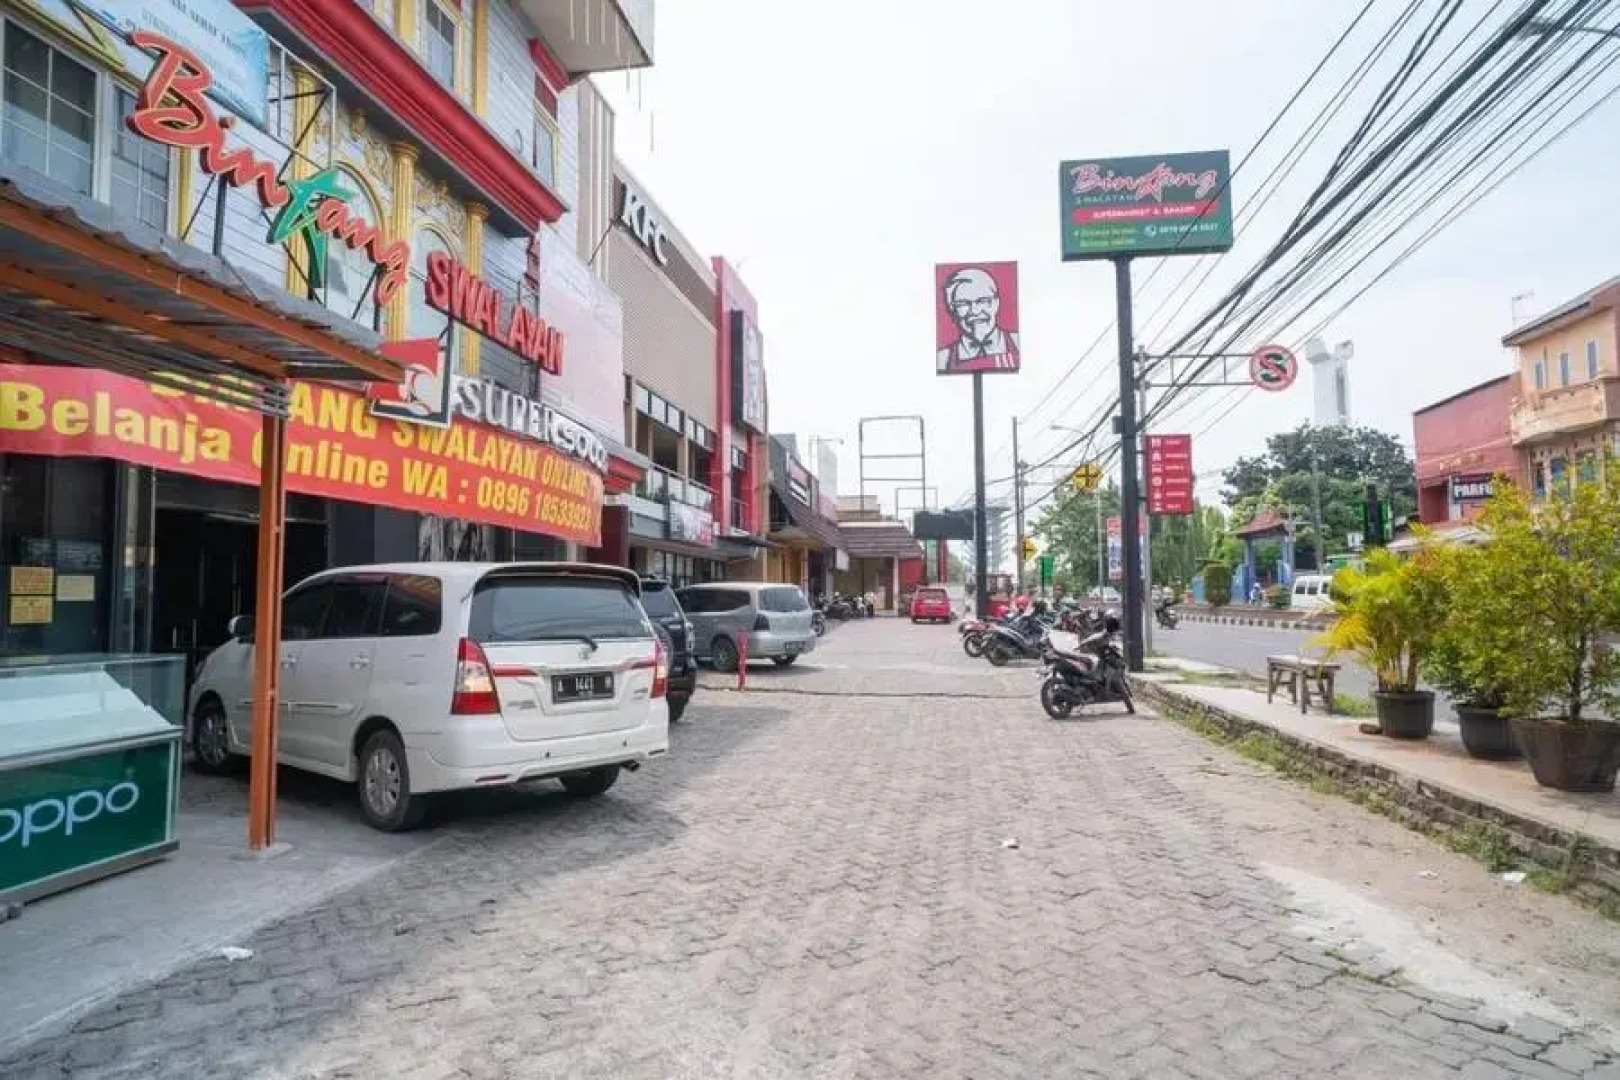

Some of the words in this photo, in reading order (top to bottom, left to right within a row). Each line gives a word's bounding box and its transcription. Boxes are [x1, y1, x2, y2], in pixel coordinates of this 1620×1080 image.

[126, 30, 411, 304] Bintang
[425, 251, 564, 376] SWALAYAN
[621, 181, 668, 266] KFC
[1070, 163, 1216, 201] Bintang
[0, 381, 231, 463] Belanja
[402, 458, 448, 499] WA
[477, 476, 530, 517] 0896
[0, 782, 139, 848] oppo
